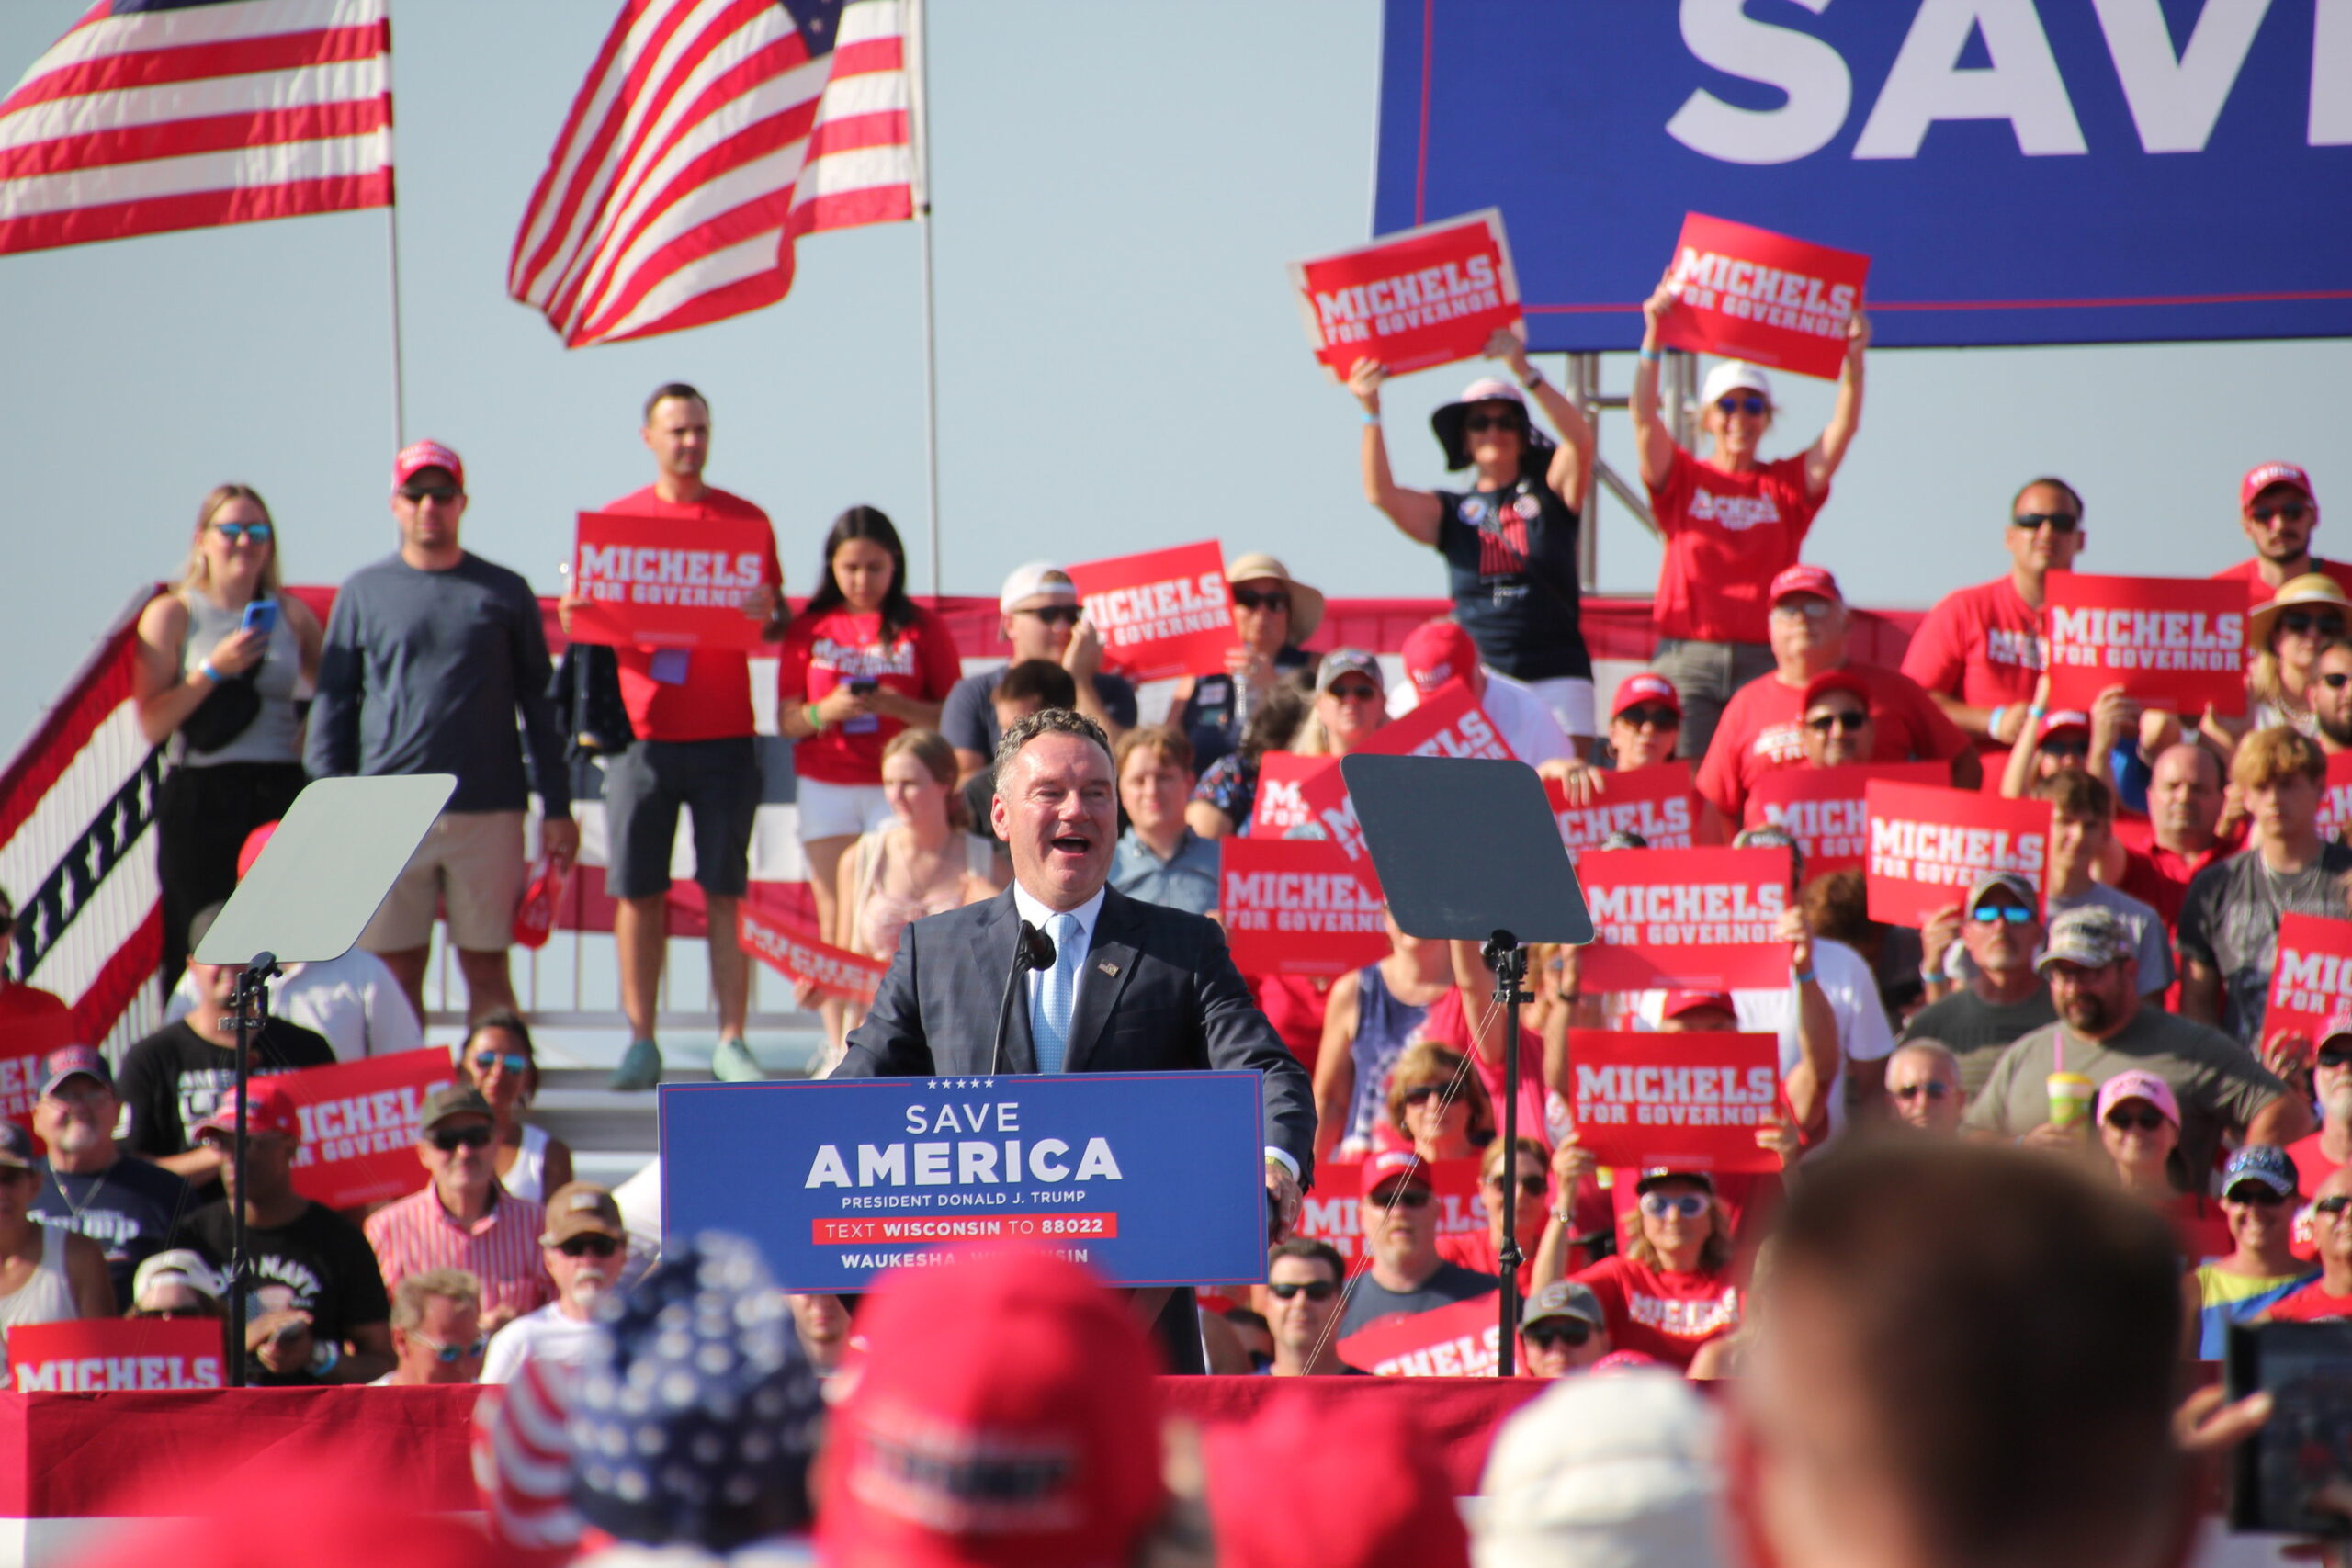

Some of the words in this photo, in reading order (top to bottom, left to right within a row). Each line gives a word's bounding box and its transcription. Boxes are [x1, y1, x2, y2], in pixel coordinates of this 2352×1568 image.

[1665, 0, 2352, 164] SAV
[1316, 254, 1495, 325] MICHELS
[1673, 246, 1855, 321] MICHELS
[1327, 321, 1370, 345] FOR
[1375, 288, 1499, 336] GOVERNOR
[1721, 294, 1849, 341] GOVERNOR
[580, 544, 762, 589] MICHELS
[579, 580, 625, 603] FOR
[631, 583, 750, 609] GOVERNO
[1113, 606, 1232, 647] GOVERNOR
[2051, 605, 2244, 650] MICHELS
[2052, 644, 2098, 668] FOR
[2105, 648, 2242, 671] GOVERNOR
[1559, 796, 1690, 846] CHELS
[1764, 800, 1866, 837] MICH
[1870, 816, 2045, 872] MICHELS
[1871, 853, 1909, 880] FOR
[1226, 872, 1384, 911] MICHEL
[1587, 885, 1784, 923] MICHELS
[1225, 909, 1269, 931] FOR
[2275, 987, 2324, 1015] FOR
[1576, 1064, 1775, 1105] MICHELS
[296, 1081, 450, 1144] ICHEL
[905, 1102, 1020, 1134] SAVE
[1576, 1104, 1628, 1124] FOR
[804, 1137, 1123, 1189] AMERICA
[842, 1194, 932, 1209] PRESIDENT
[937, 1192, 1006, 1207] DONALD
[1012, 1192, 1025, 1204] J.
[1031, 1190, 1086, 1203] TRUMP
[825, 1224, 876, 1238] TEXT
[883, 1221, 1001, 1236] WISCONSIN
[1009, 1220, 1034, 1235] TO
[1041, 1218, 1103, 1234] 88022
[15, 1355, 220, 1393] MICHELS
